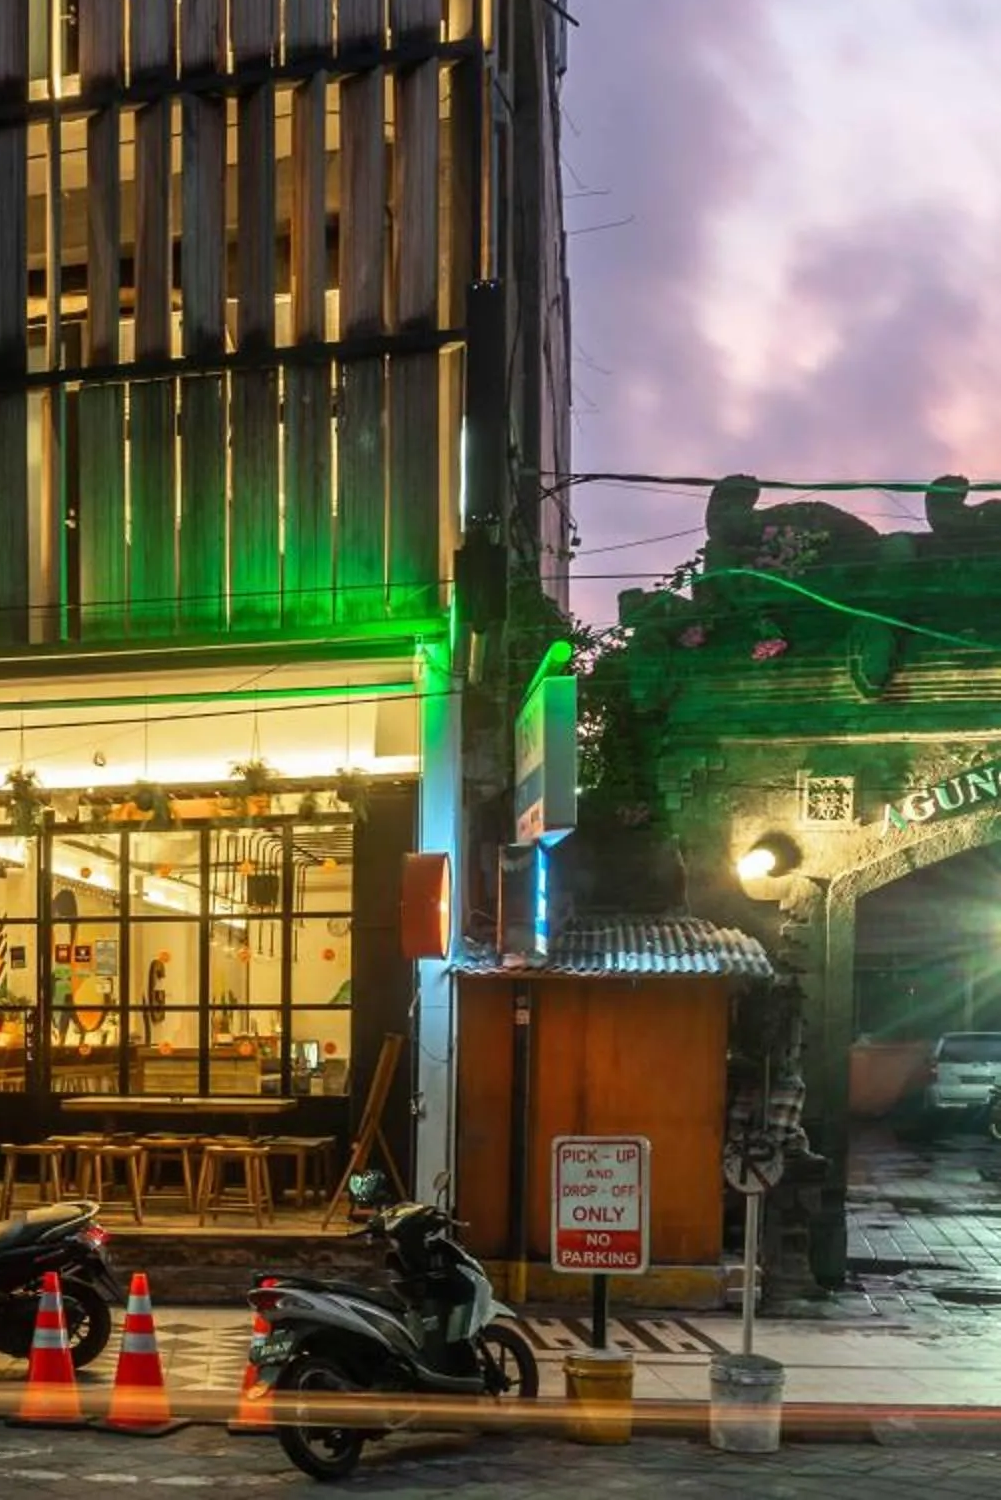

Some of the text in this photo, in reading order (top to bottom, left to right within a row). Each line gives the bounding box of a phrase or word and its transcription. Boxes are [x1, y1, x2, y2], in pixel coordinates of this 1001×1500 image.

[879, 767, 1001, 838] AGUN
[562, 1148, 598, 1163] PICK
[616, 1148, 636, 1162] UP
[586, 1169, 614, 1179] AND
[562, 1185, 598, 1197] DROP
[611, 1185, 636, 1197] OFF
[572, 1205, 625, 1222] ONLY
[586, 1233, 611, 1246] NO
[561, 1250, 637, 1265] PARKING
